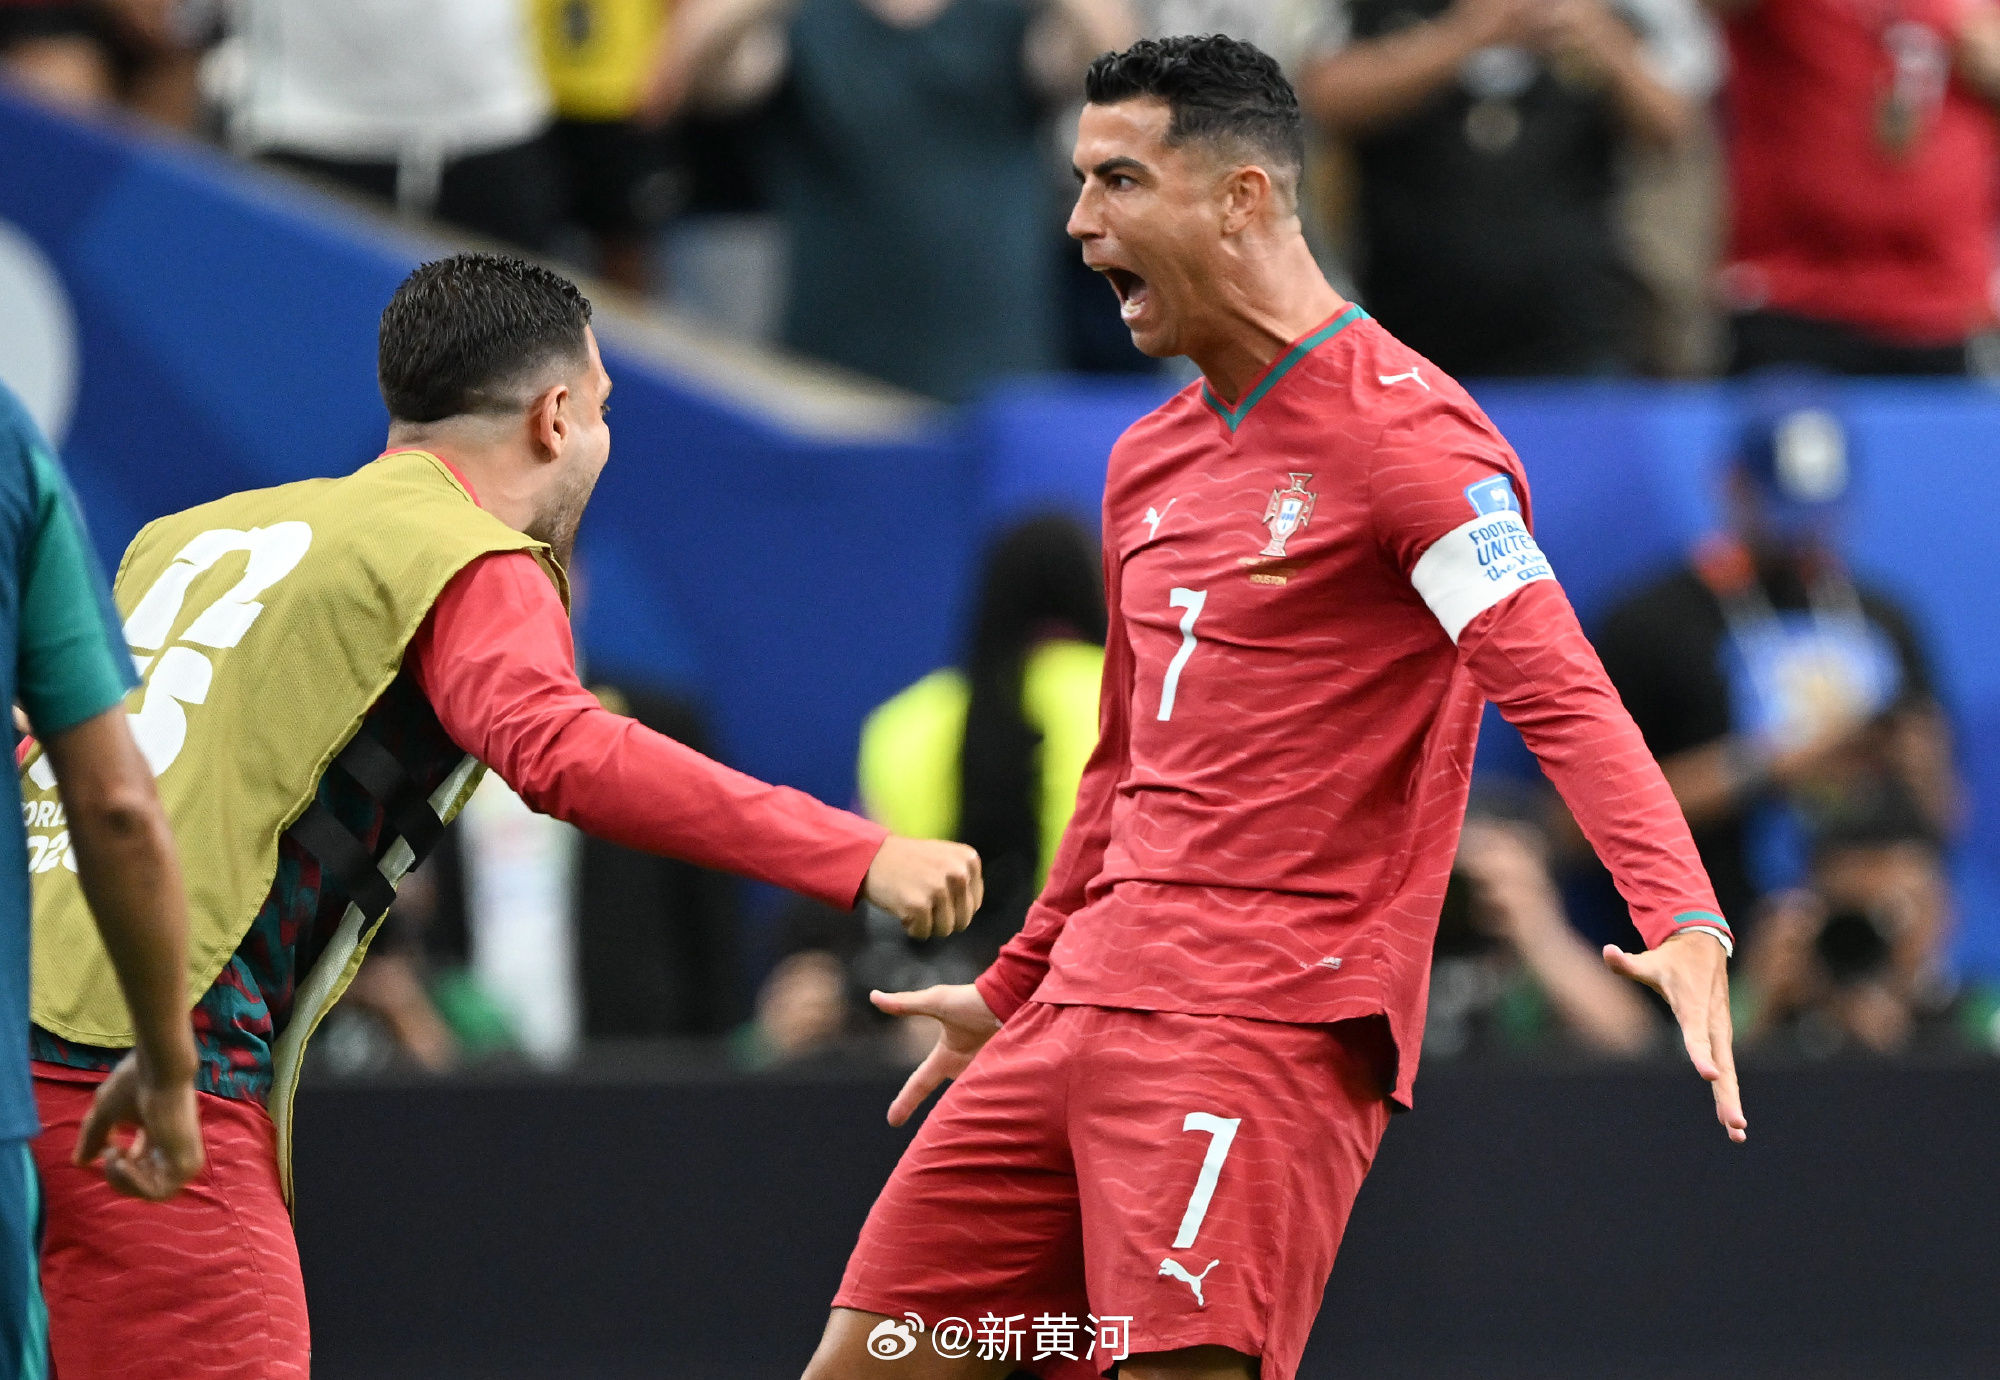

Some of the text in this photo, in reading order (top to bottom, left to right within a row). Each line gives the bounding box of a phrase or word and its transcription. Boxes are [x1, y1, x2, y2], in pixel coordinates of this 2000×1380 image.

[1156, 587, 1208, 721] 7
[21, 800, 68, 828] ORL
[1171, 1111, 1242, 1249] 7
